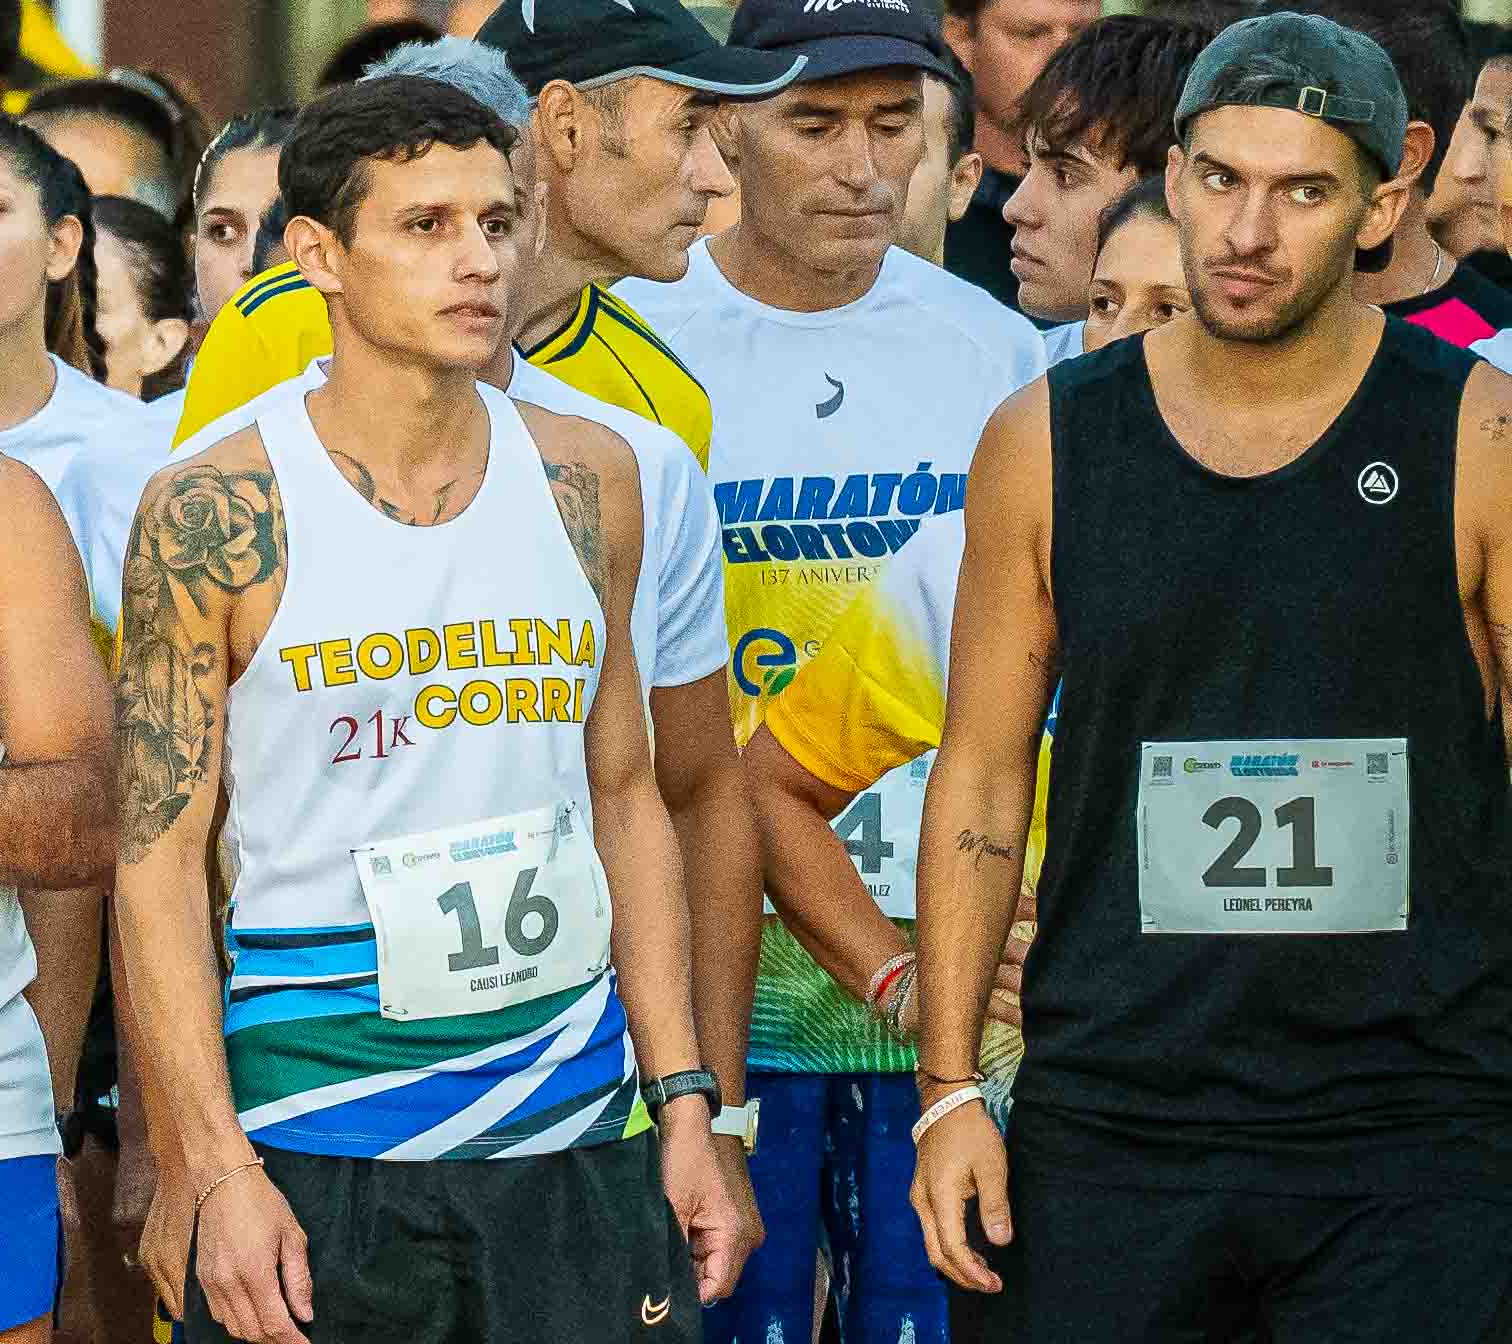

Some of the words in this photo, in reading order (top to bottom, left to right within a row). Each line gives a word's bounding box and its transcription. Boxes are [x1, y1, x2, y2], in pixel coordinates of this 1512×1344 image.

[714, 462, 968, 524] MARATÓN
[761, 569, 790, 585] 137
[797, 567, 879, 585] ANIVER
[280, 618, 596, 692] TEODELINA
[1201, 796, 1333, 887] 21
[437, 866, 559, 972] 16
[1224, 898, 1262, 912] LEONEL
[1264, 898, 1313, 912] PEREYRA
[470, 975, 498, 992] CAUSI
[500, 966, 538, 986] LEANDRO
